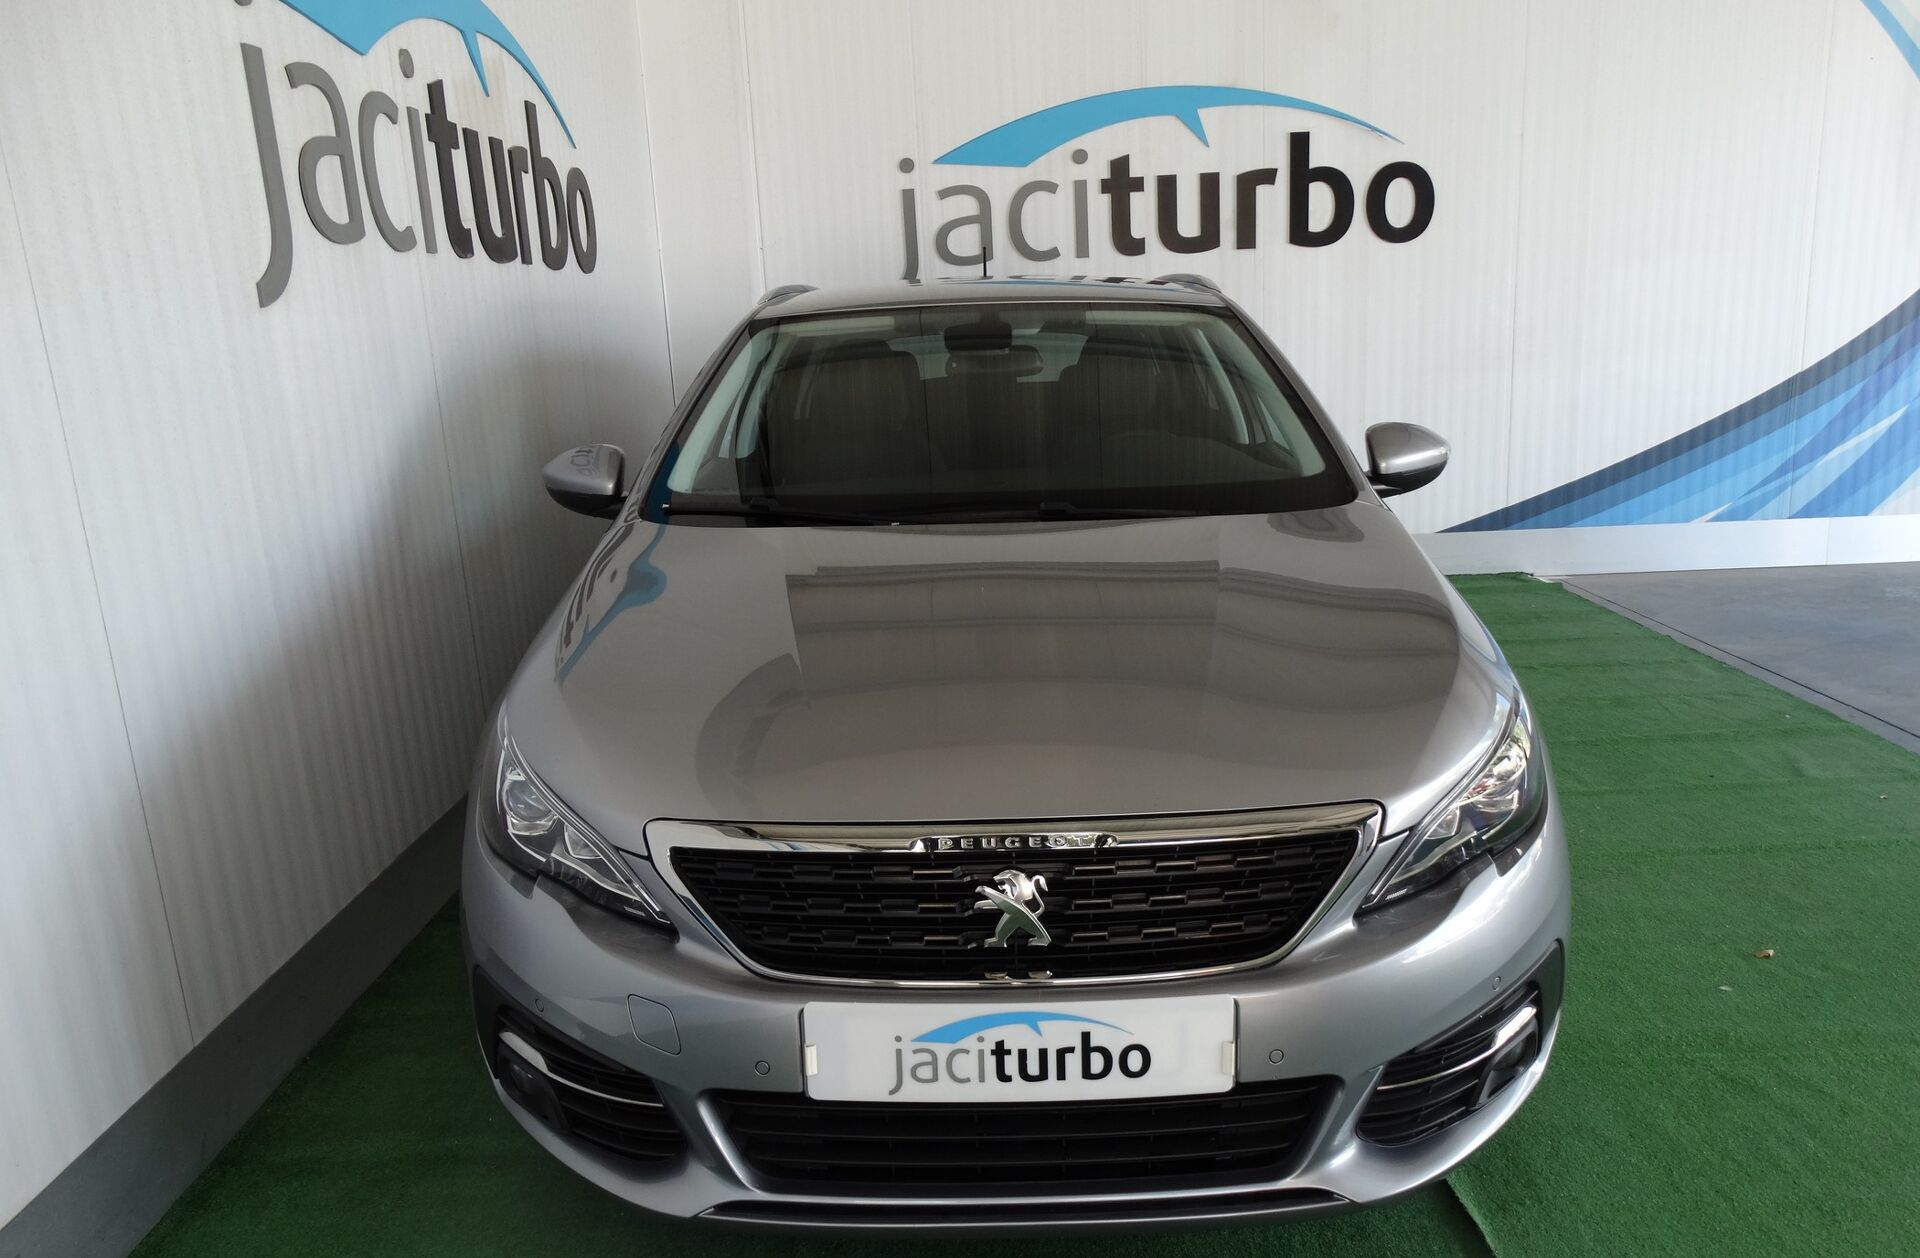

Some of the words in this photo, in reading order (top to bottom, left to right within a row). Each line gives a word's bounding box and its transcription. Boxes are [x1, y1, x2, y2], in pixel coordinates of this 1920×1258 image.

[234, 0, 597, 308] jaciturbo
[899, 132, 1435, 280] jaciturbo
[939, 835, 1092, 849] PEUGEOT
[889, 1032, 1151, 1095] jaciturbo
